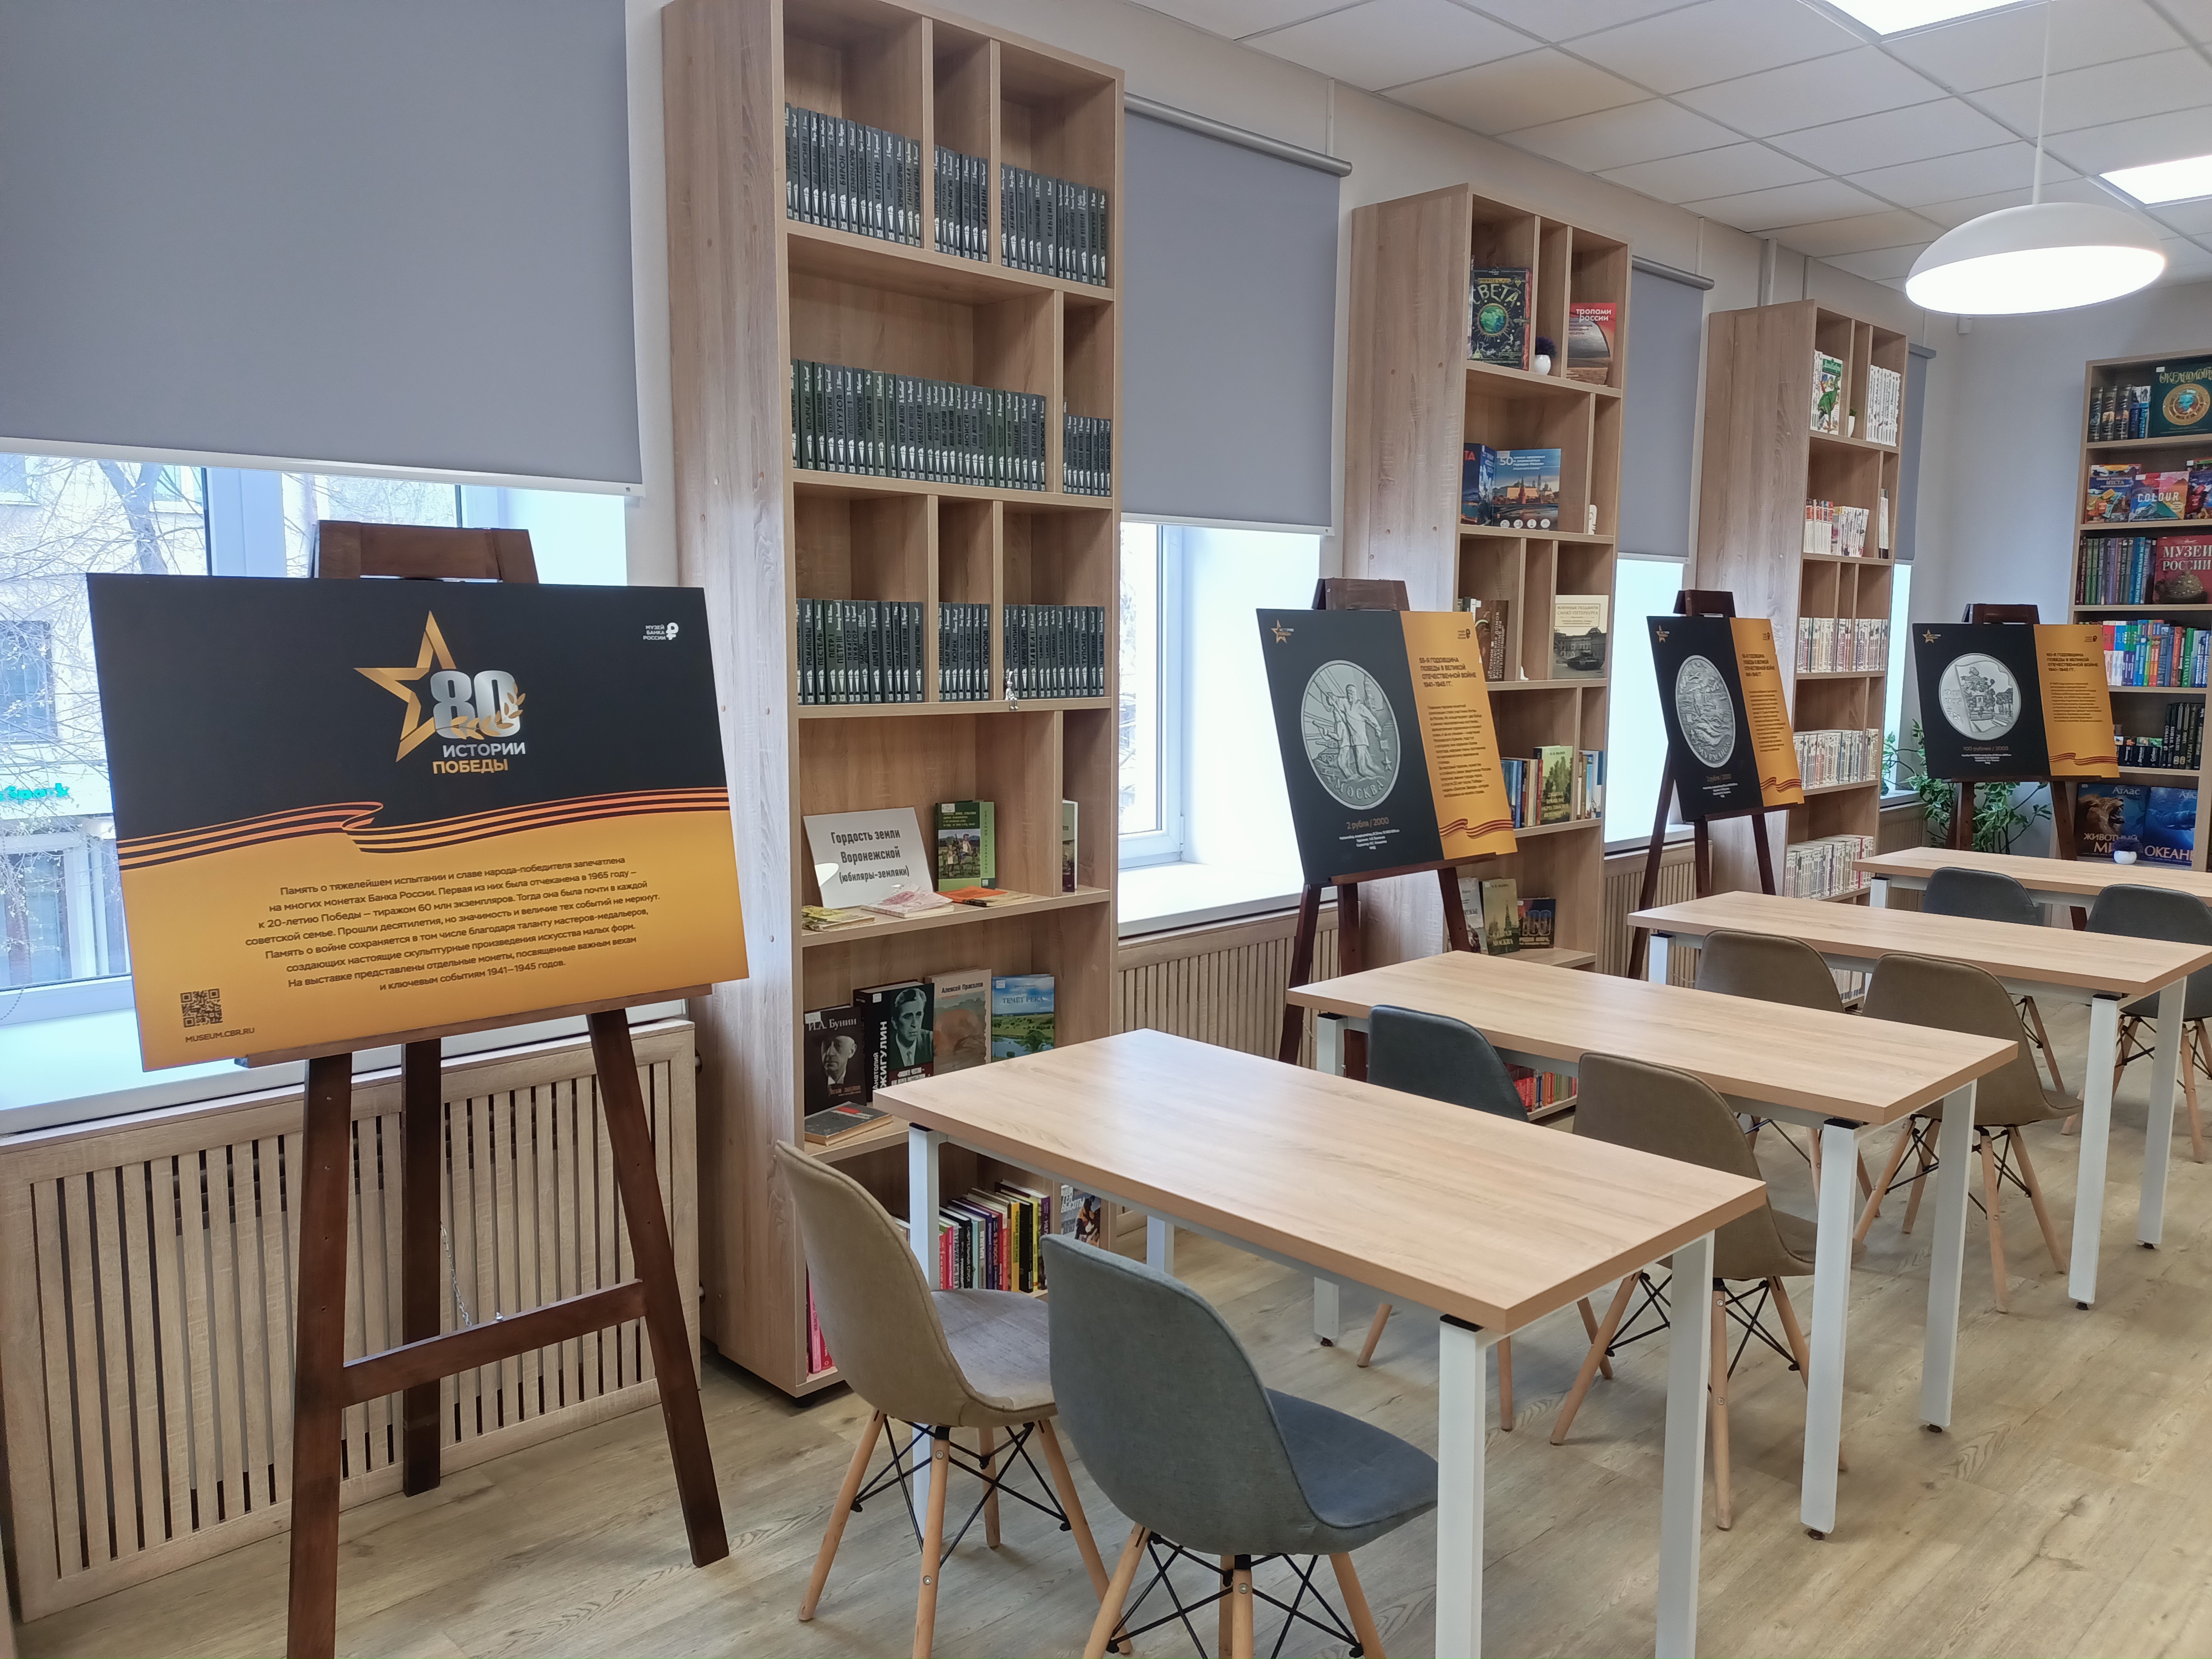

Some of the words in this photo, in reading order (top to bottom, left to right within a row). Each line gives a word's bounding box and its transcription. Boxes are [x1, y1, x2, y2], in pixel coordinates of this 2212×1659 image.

[1500, 457, 1513, 466] 50
[2137, 492, 2179, 503] COLOUR
[2163, 560, 2211, 571] РОССИИ
[430, 670, 520, 739] 80
[443, 742, 526, 758] ИСТОРИИ
[433, 758, 508, 774] ПОБЕДЫ
[1334, 779, 1384, 800] МОСКВА
[2112, 786, 2140, 795] Атлас
[1373, 817, 1389, 826] 2000
[831, 832, 873, 846] Гордость
[874, 830, 901, 839] земли
[841, 846, 901, 865] Воронежской
[280, 886, 319, 896] Память
[328, 879, 393, 891] тяжелейшем
[394, 874, 447, 885] испытании
[456, 870, 483, 879] славе
[484, 863, 572, 877] народа-победителя
[573, 857, 625, 868] запечатлена
[839, 865, 910, 884] (юбиляры-земляки)
[284, 901, 322, 911] многих
[324, 896, 367, 907] монетах
[368, 893, 398, 902] Банка
[399, 890, 437, 899] России.
[438, 886, 473, 896] Первая
[505, 880, 528, 889] была
[529, 875, 580, 886] отчеканена
[587, 871, 609, 880] 1965
[610, 870, 629, 879] году
[267, 916, 319, 928] 20-летию
[321, 911, 362, 922] Победы
[372, 906, 416, 917] тиражом
[418, 903, 432, 912] 60
[453, 896, 516, 909] экземпляров.
[515, 893, 541, 901] Тогда
[560, 889, 582, 897] была
[583, 886, 609, 894] почти
[617, 880, 648, 891] каждой
[245, 931, 301, 946] советской
[302, 930, 336, 940] семье.
[337, 925, 378, 937] Прошли
[379, 918, 444, 932] десятилетия,
[458, 911, 512, 922] значимость
[521, 905, 558, 915] величие
[575, 898, 612, 909] событий
[624, 894, 660, 904] меркнут.
[265, 949, 305, 959] Память
[315, 943, 347, 953] войне
[348, 936, 411, 950] сохраняется
[419, 933, 438, 941] том
[439, 930, 467, 938] числе
[468, 924, 516, 935] благодаря
[517, 920, 553, 930] таланту
[554, 909, 649, 925] мастеров-медальеров,
[286, 959, 346, 972] создающих
[347, 952, 402, 965] настоящие
[403, 943, 471, 958] скульптурные
[471, 936, 536, 951] произведения
[538, 930, 582, 941] искусства
[582, 926, 610, 936] малых
[611, 924, 636, 933] форм.
[288, 979, 303, 988] На
[304, 973, 353, 985] выставке
[354, 964, 425, 980] представлены
[426, 957, 477, 969] отдельные
[478, 953, 515, 963] монеты,
[515, 945, 576, 958] посвященные
[577, 940, 611, 950] важным
[612, 937, 637, 946] вехам
[388, 977, 439, 990] ключевым
[440, 971, 486, 983] событиям
[538, 960, 566, 969] годов.
[941, 984, 961, 993] Алексей
[962, 982, 983, 990] Прасолов
[829, 1018, 857, 1030] Бунин
[185, 1027, 255, 1042] MUSEUM.CBR.RU
